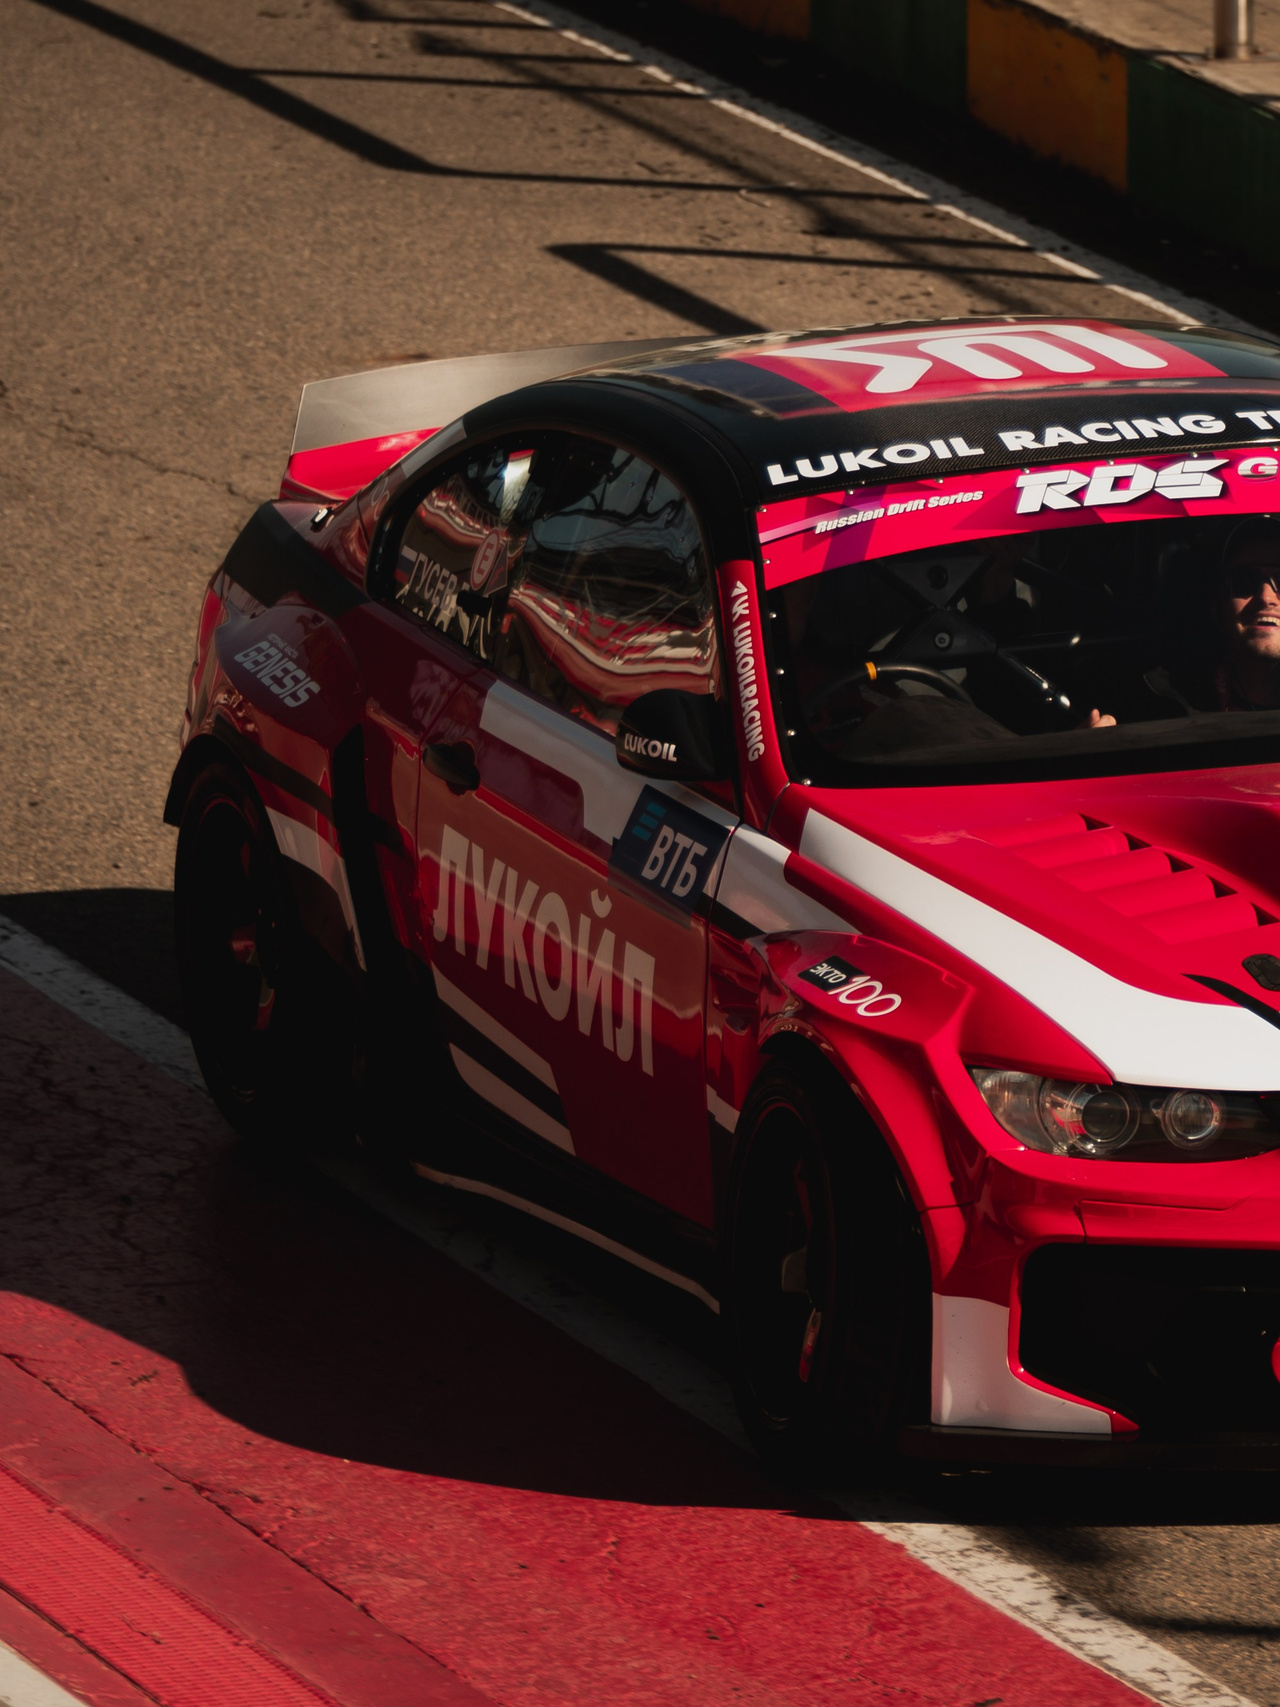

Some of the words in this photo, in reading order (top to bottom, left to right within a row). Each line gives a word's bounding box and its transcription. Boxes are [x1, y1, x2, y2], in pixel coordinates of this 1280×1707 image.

[766, 437, 985, 486] LUKOIL
[998, 411, 1226, 452] RACING
[814, 506, 885, 535] Russian
[887, 498, 927, 517] Drift
[927, 490, 984, 509] Series
[1015, 458, 1230, 514] RDS
[233, 641, 321, 708] GENESIS
[732, 620, 766, 762] LUKOILRACING
[624, 732, 678, 763] LUKOIL
[641, 824, 708, 898] ВТБ
[432, 824, 657, 1077] ЛУКОЙЛ
[809, 962, 847, 984] ЭКТО
[828, 975, 902, 1016] 100
